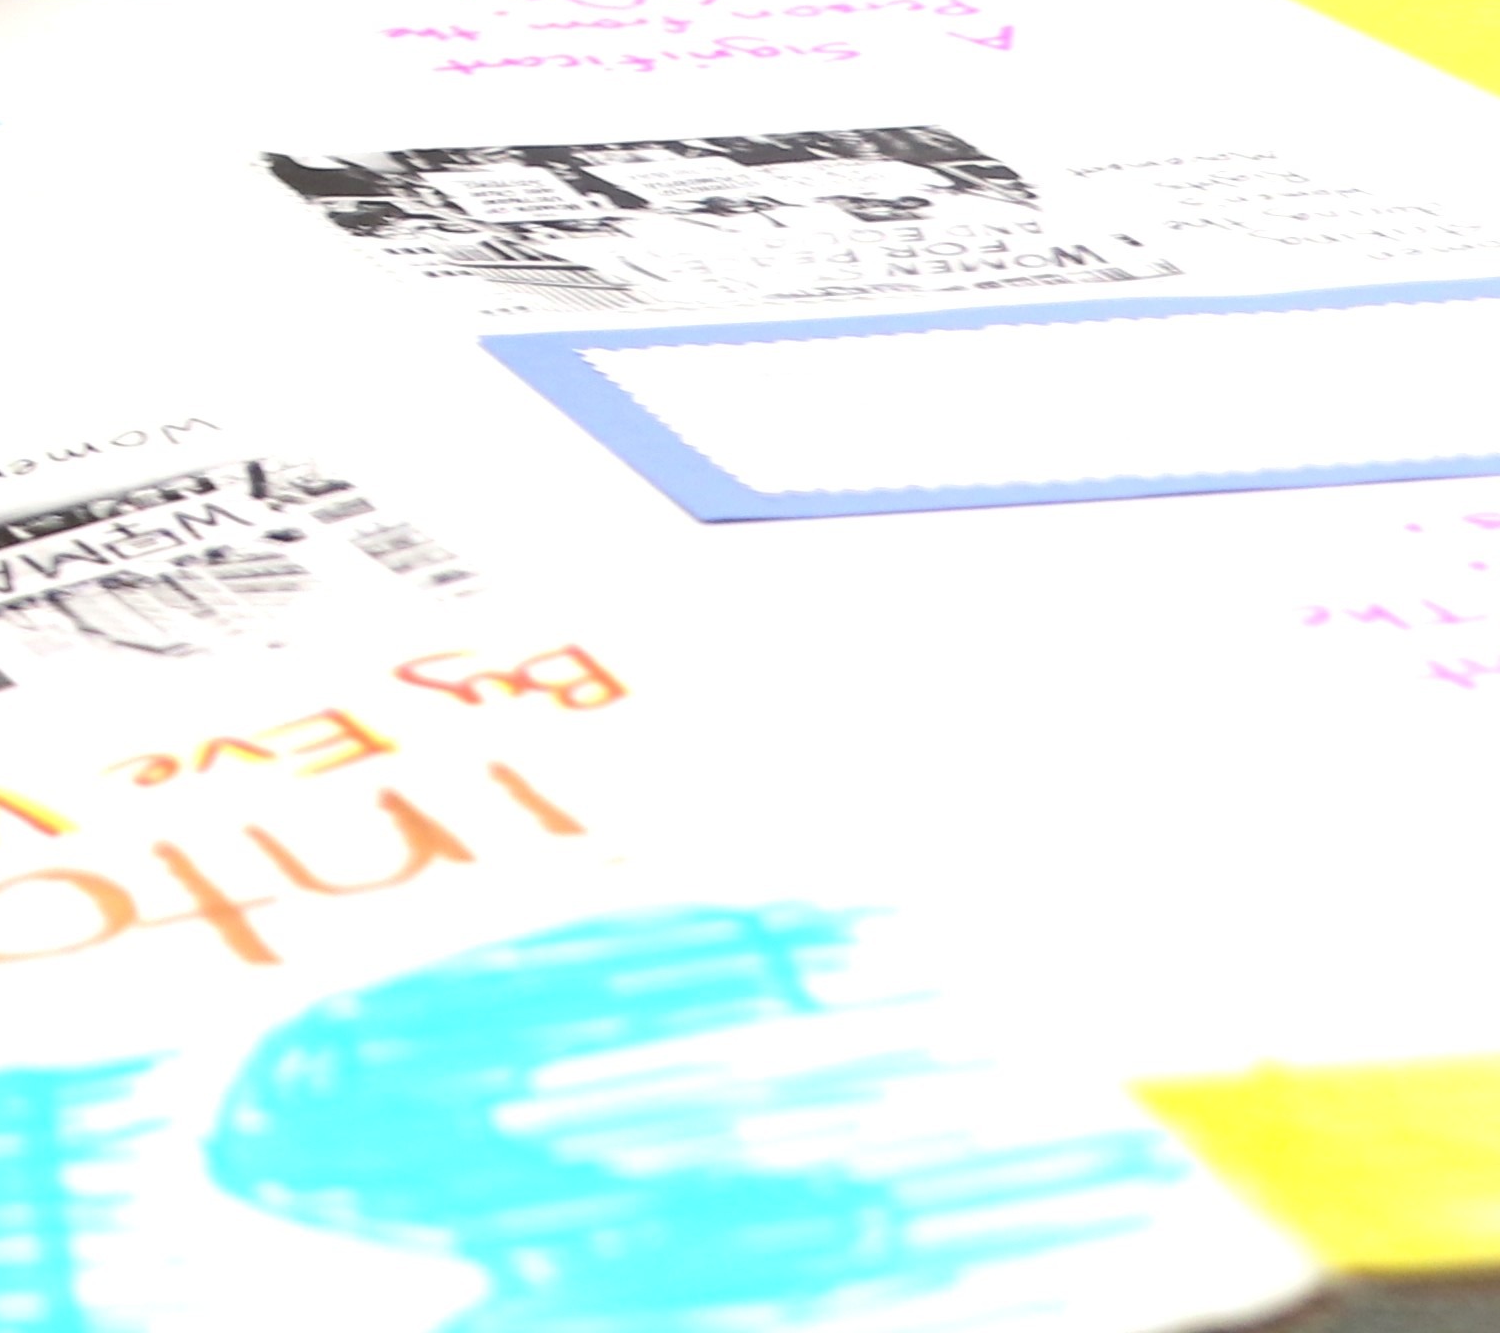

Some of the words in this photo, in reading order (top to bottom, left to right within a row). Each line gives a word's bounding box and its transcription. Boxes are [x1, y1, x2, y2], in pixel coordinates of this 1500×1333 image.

[945, 25, 1016, 51] A
[879, 240, 1010, 259] FOR
[884, 244, 1108, 278] WOMEN
[393, 643, 630, 713] By
[102, 708, 397, 790] Eve
